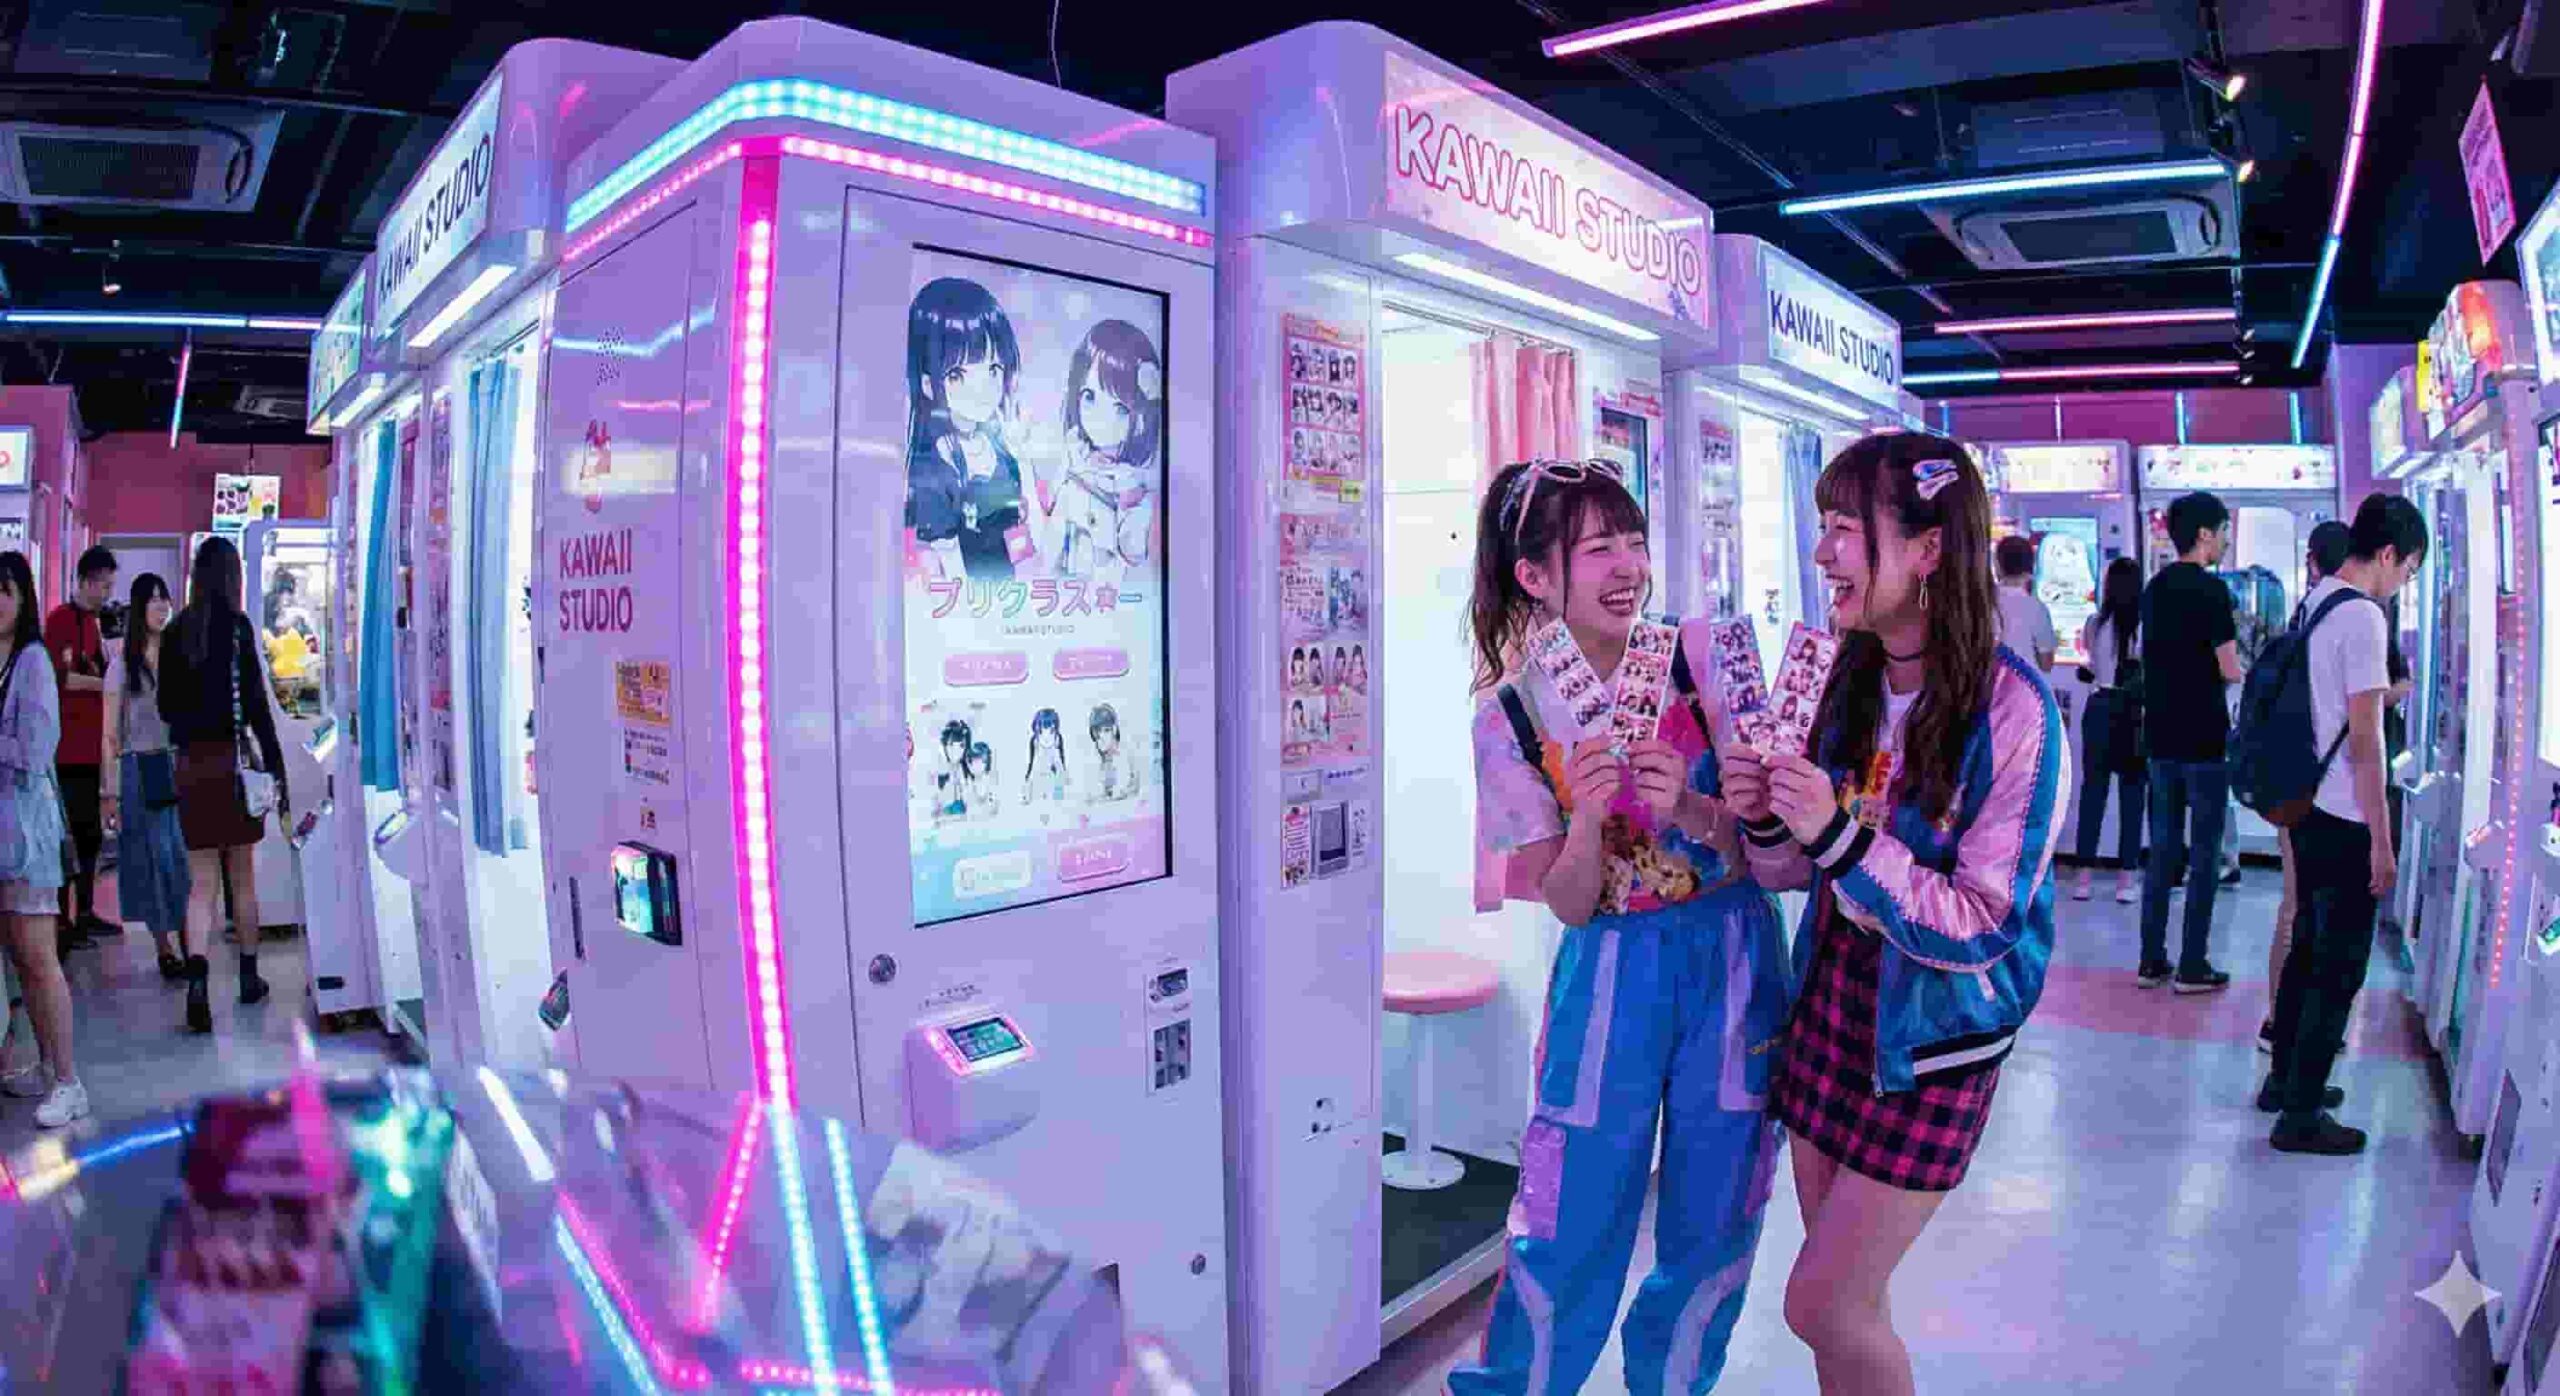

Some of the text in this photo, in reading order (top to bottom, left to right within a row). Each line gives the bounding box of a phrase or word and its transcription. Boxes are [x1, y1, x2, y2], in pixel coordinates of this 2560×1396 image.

[380, 131, 491, 301] KAWAII STUDIO
[1394, 102, 1701, 298] KAWAII STUDIO
[1770, 290, 1894, 386] KAWAII STUDIO
[559, 527, 632, 579] KAWAII
[559, 586, 633, 633] STUDIO
